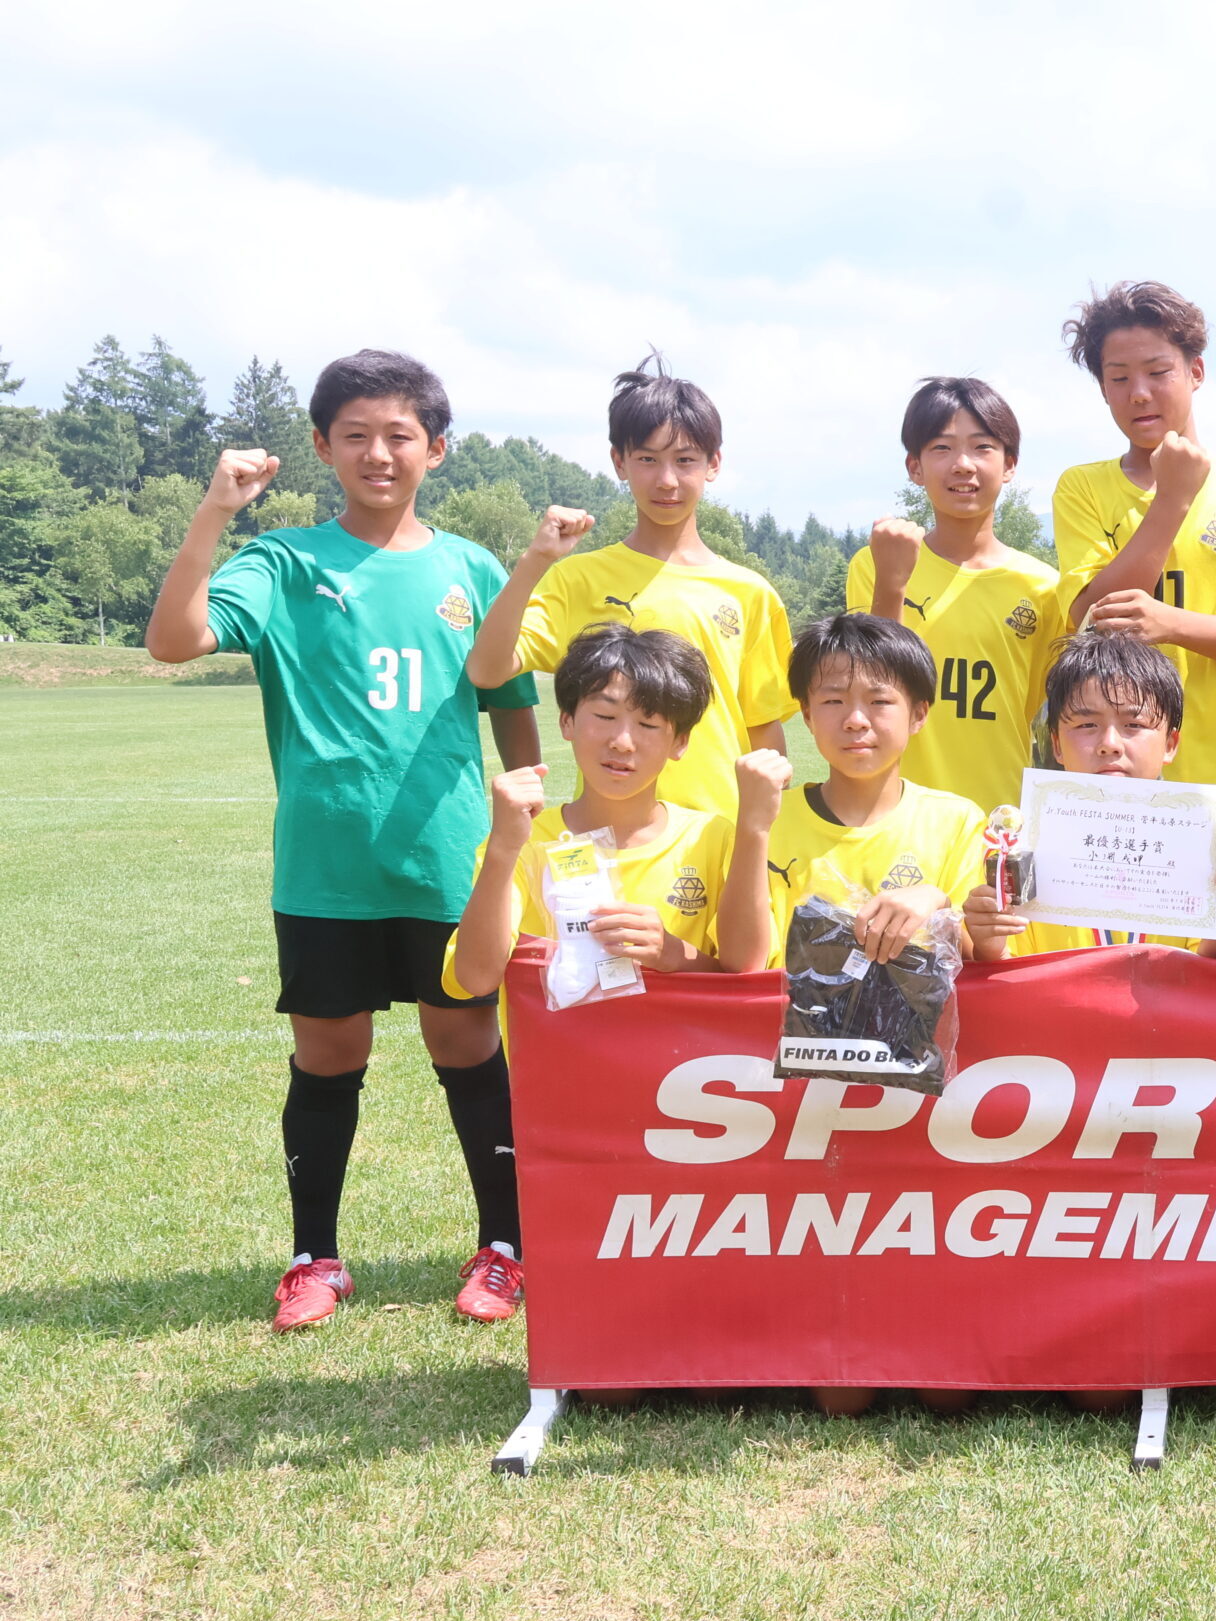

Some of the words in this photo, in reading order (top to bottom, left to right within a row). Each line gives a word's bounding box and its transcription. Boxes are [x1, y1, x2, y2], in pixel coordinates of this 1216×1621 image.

[368, 647, 422, 711] 31
[941, 658, 996, 720] 42
[1080, 810, 1102, 819] FESTA
[1105, 812, 1135, 822] SUMMER
[1083, 835, 1165, 854] 最優秀選手賞
[783, 1047, 838, 1061] FINTA
[842, 1050, 871, 1061] DO
